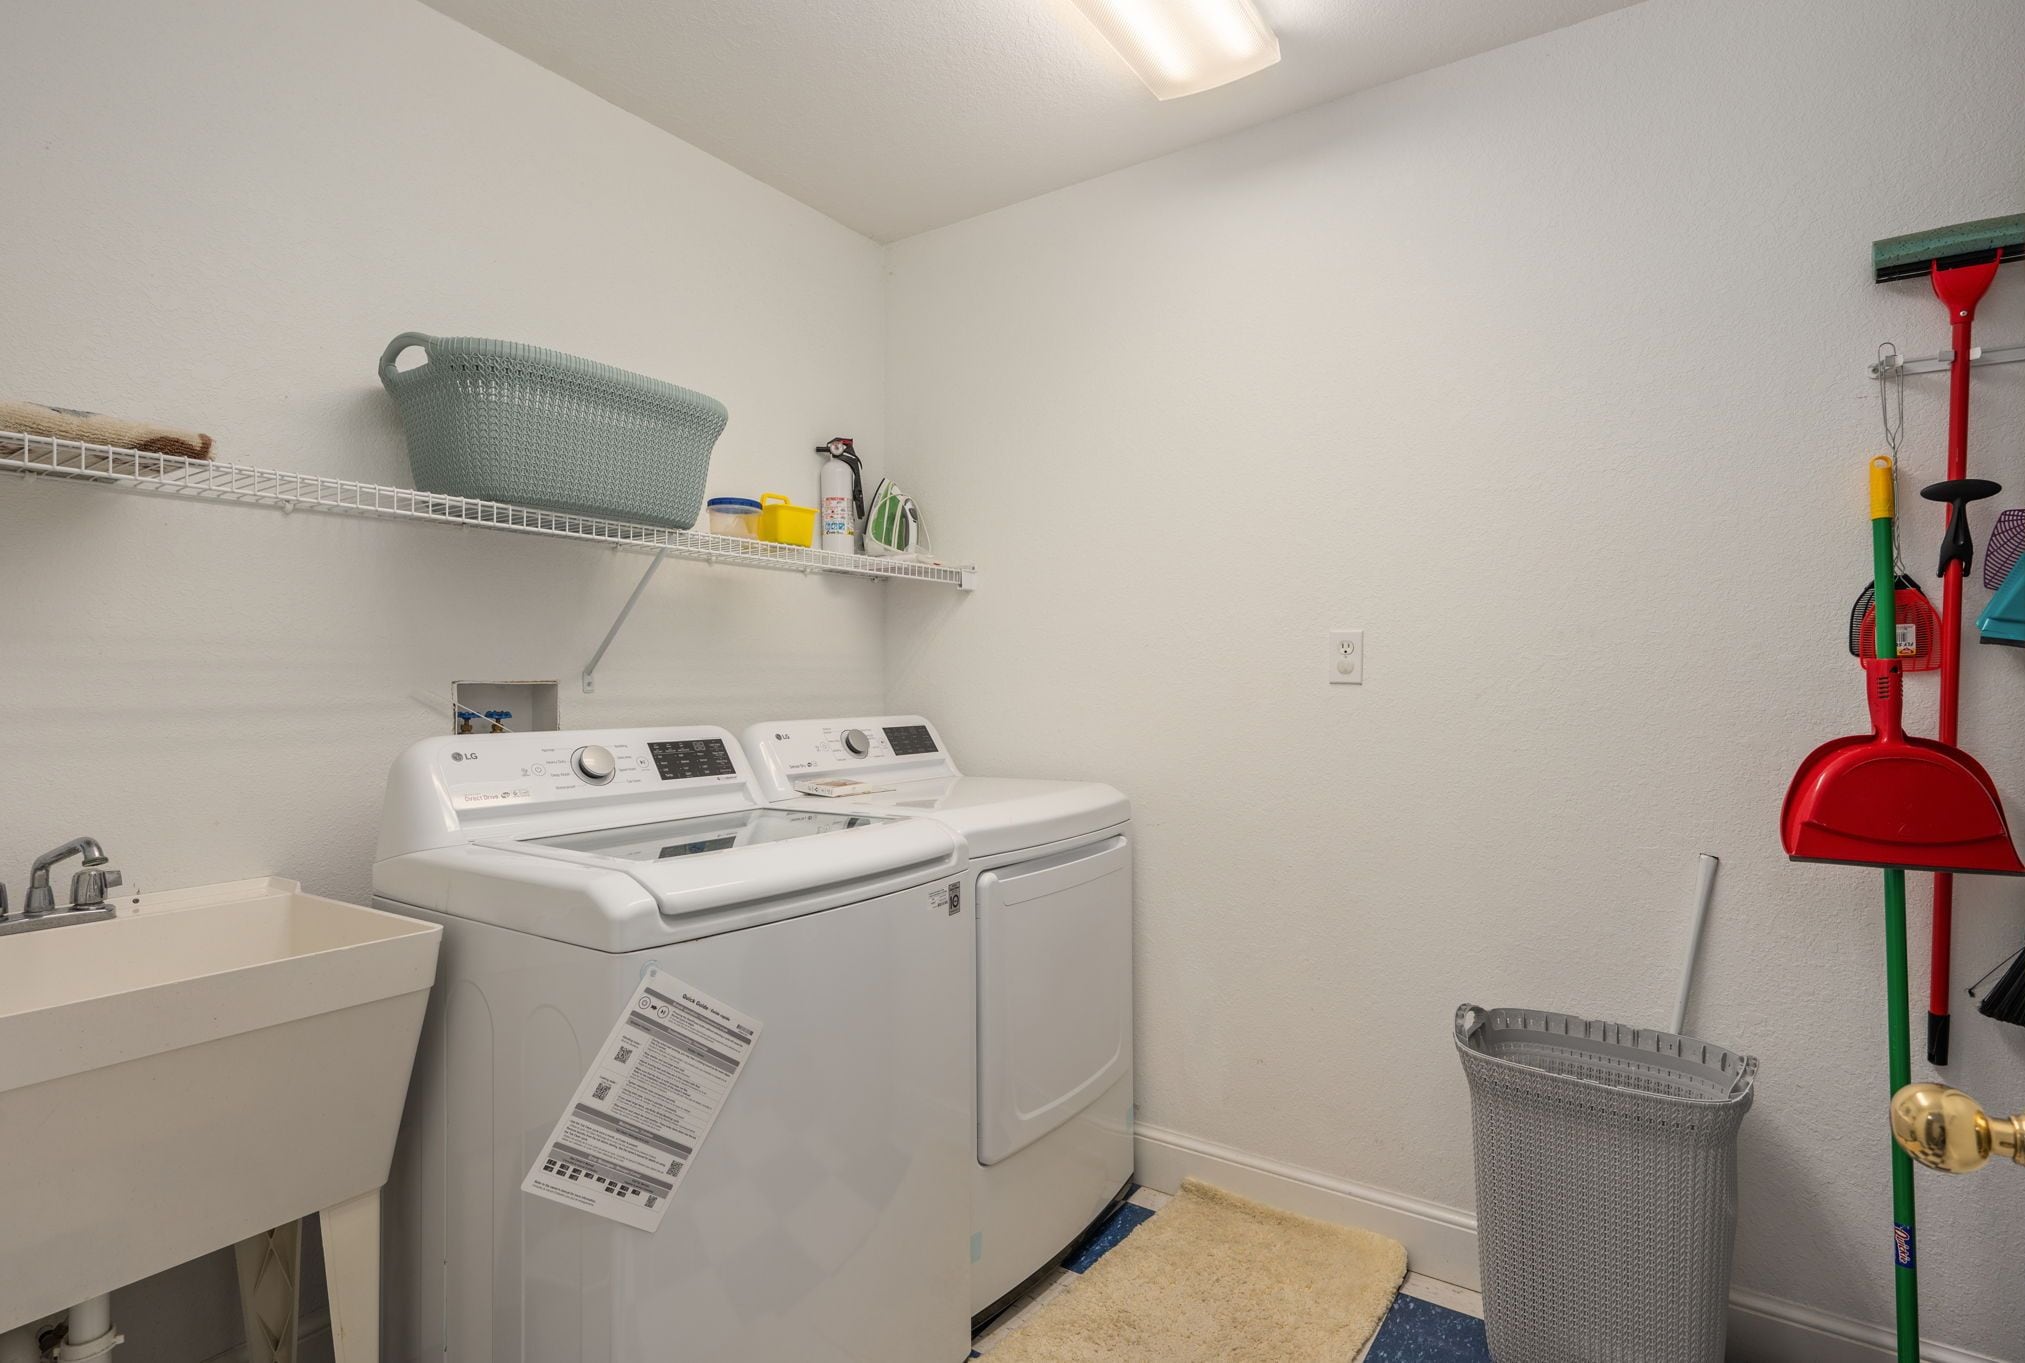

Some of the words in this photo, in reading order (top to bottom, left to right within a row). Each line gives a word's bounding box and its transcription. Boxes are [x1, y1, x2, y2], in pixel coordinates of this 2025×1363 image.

[464, 752, 478, 760] LG
[682, 993, 695, 1003] Quick
[696, 1000, 709, 1010] Guide
